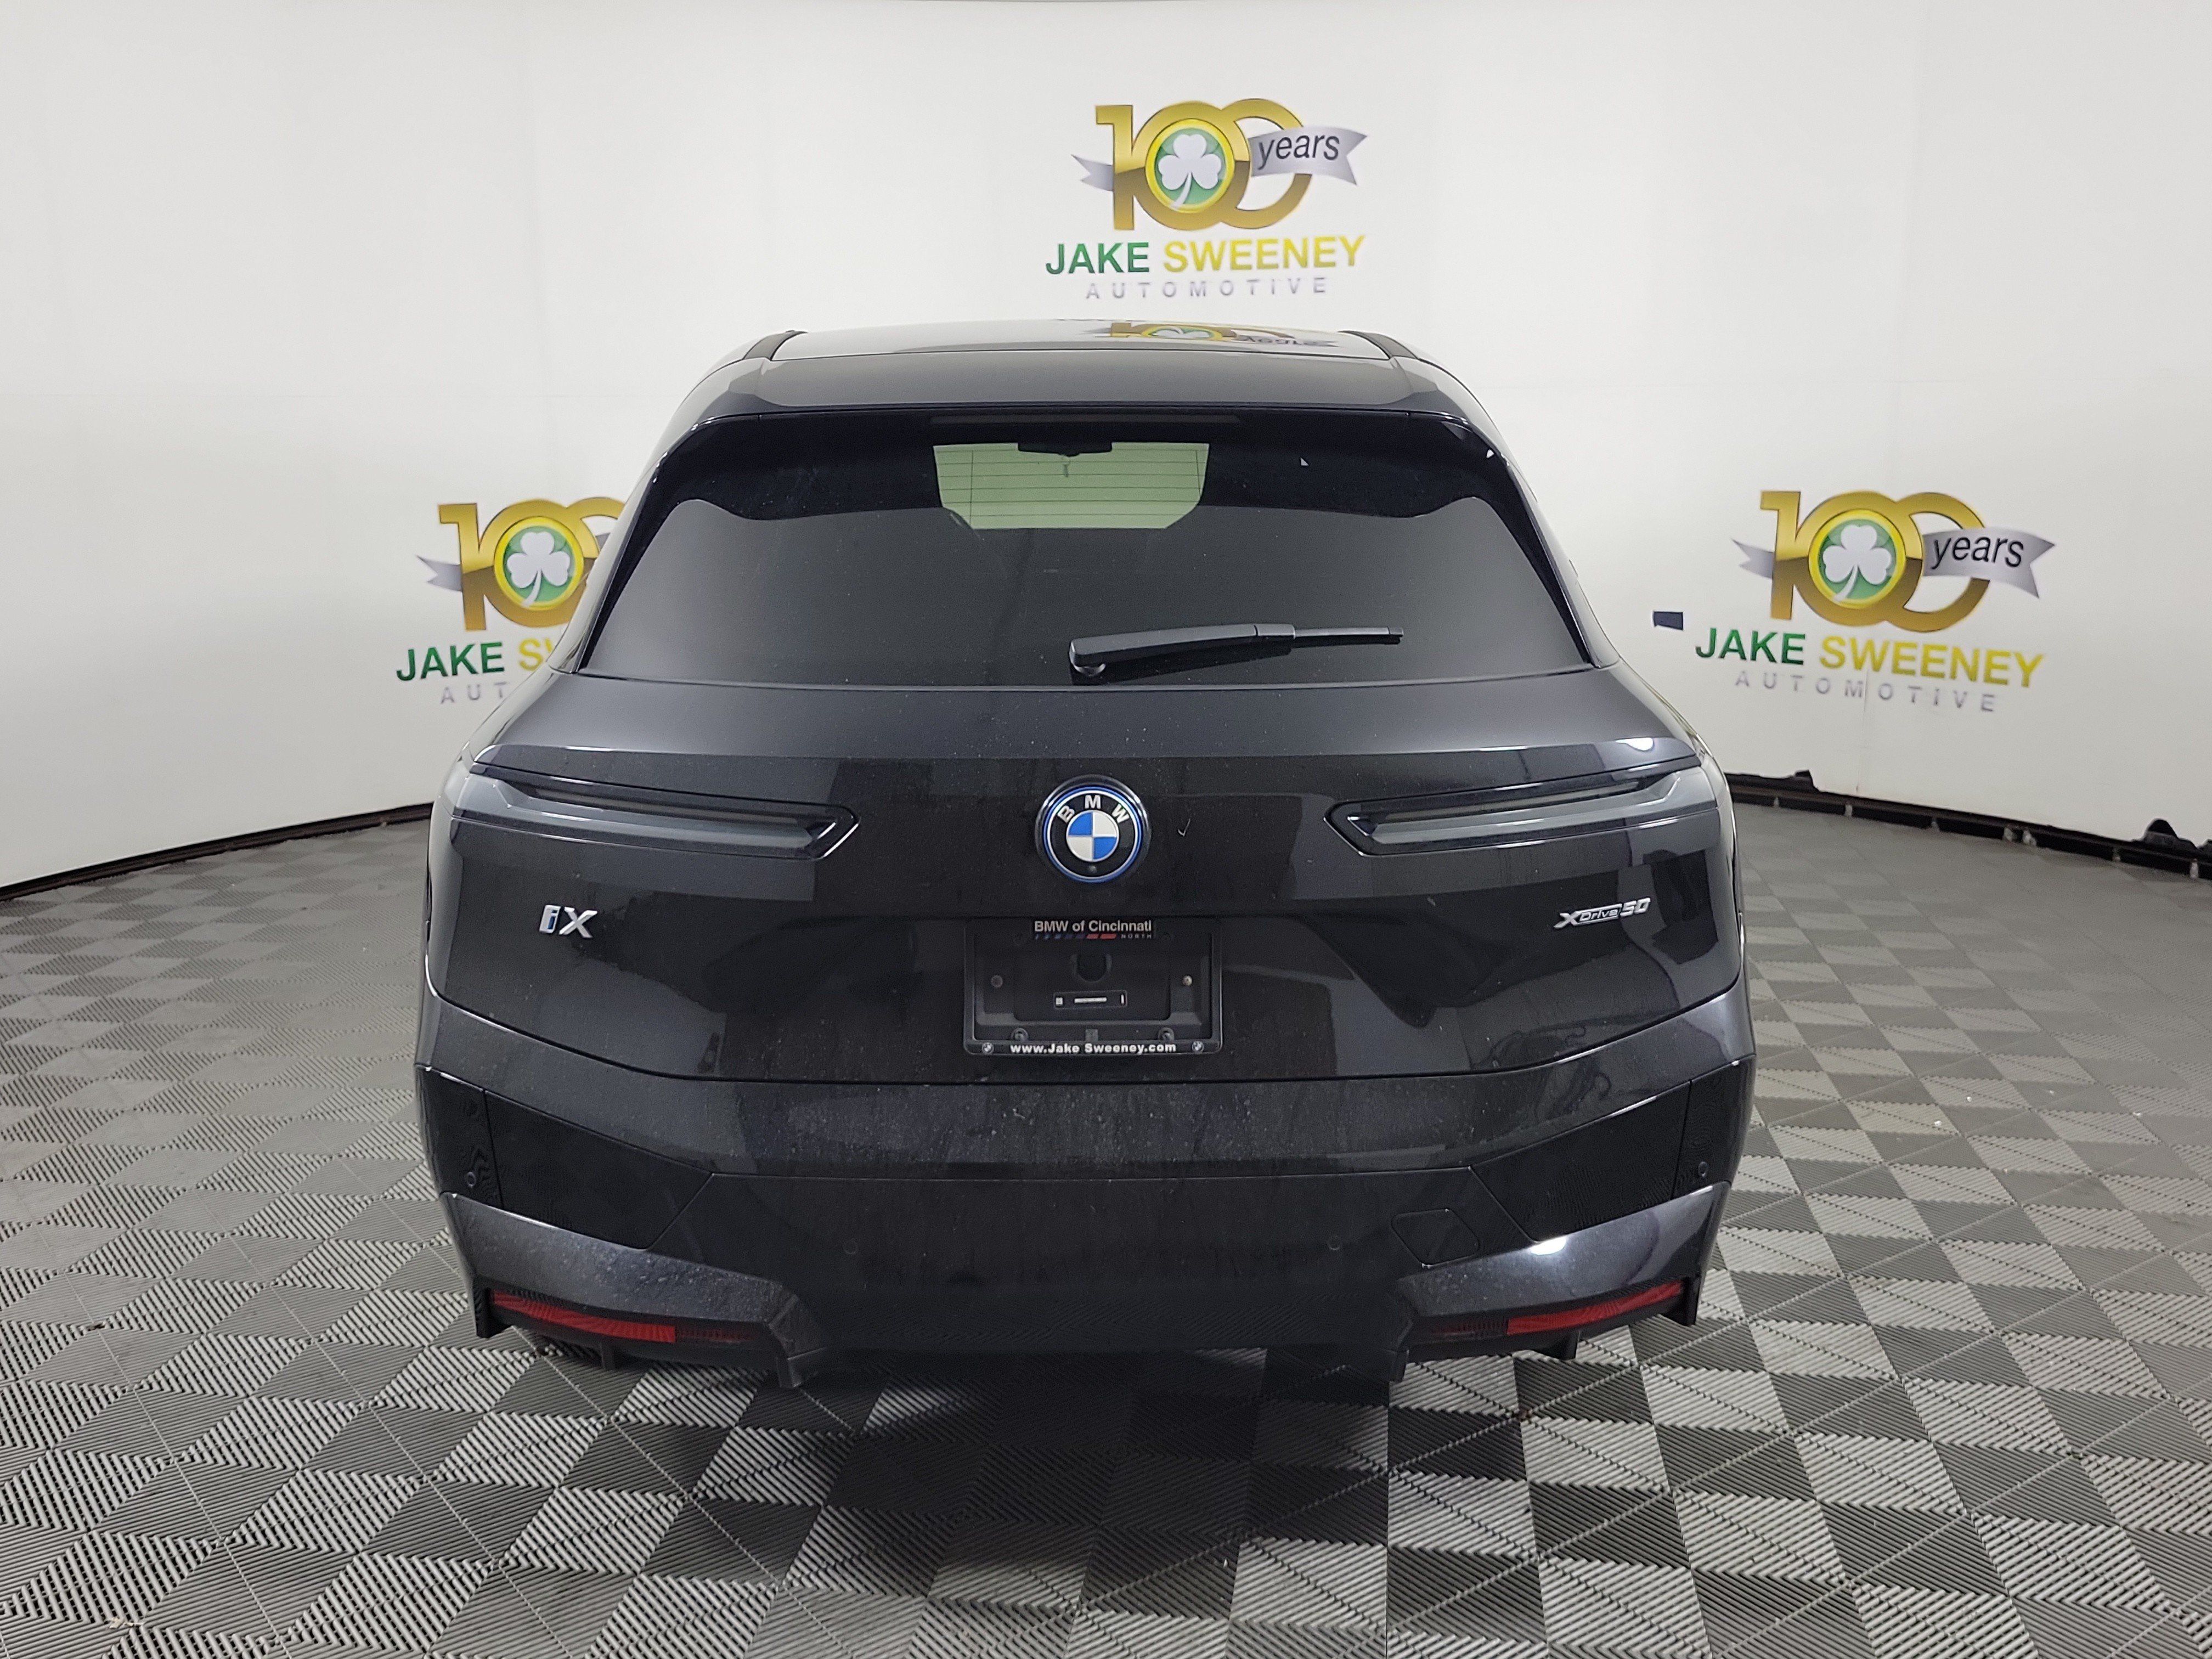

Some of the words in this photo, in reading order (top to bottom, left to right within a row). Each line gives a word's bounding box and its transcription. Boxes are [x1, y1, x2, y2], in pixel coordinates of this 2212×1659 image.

[1095, 98, 1312, 230] 100
[1257, 133, 1340, 170] years
[1046, 242, 1149, 274] JAKE
[1163, 235, 1366, 273] SWEENEY
[1086, 277, 1327, 300] AUTOMOTIVE
[1760, 490, 1991, 633] 100
[1930, 535, 2025, 570] years
[396, 641, 505, 682] JAKE
[1695, 627, 1807, 666] JAKE
[1819, 635, 2045, 689] SWEENEY
[1735, 670, 1997, 713] AUTOMOTIVE
[1058, 794, 1130, 824] BMW
[1034, 920, 1069, 932] BMW
[1072, 920, 1085, 932] of
[1088, 919, 1152, 932] Cincinnati
[1010, 1043, 1080, 1053] www.Jake
[1084, 1043, 1177, 1055] Sweeney.com
